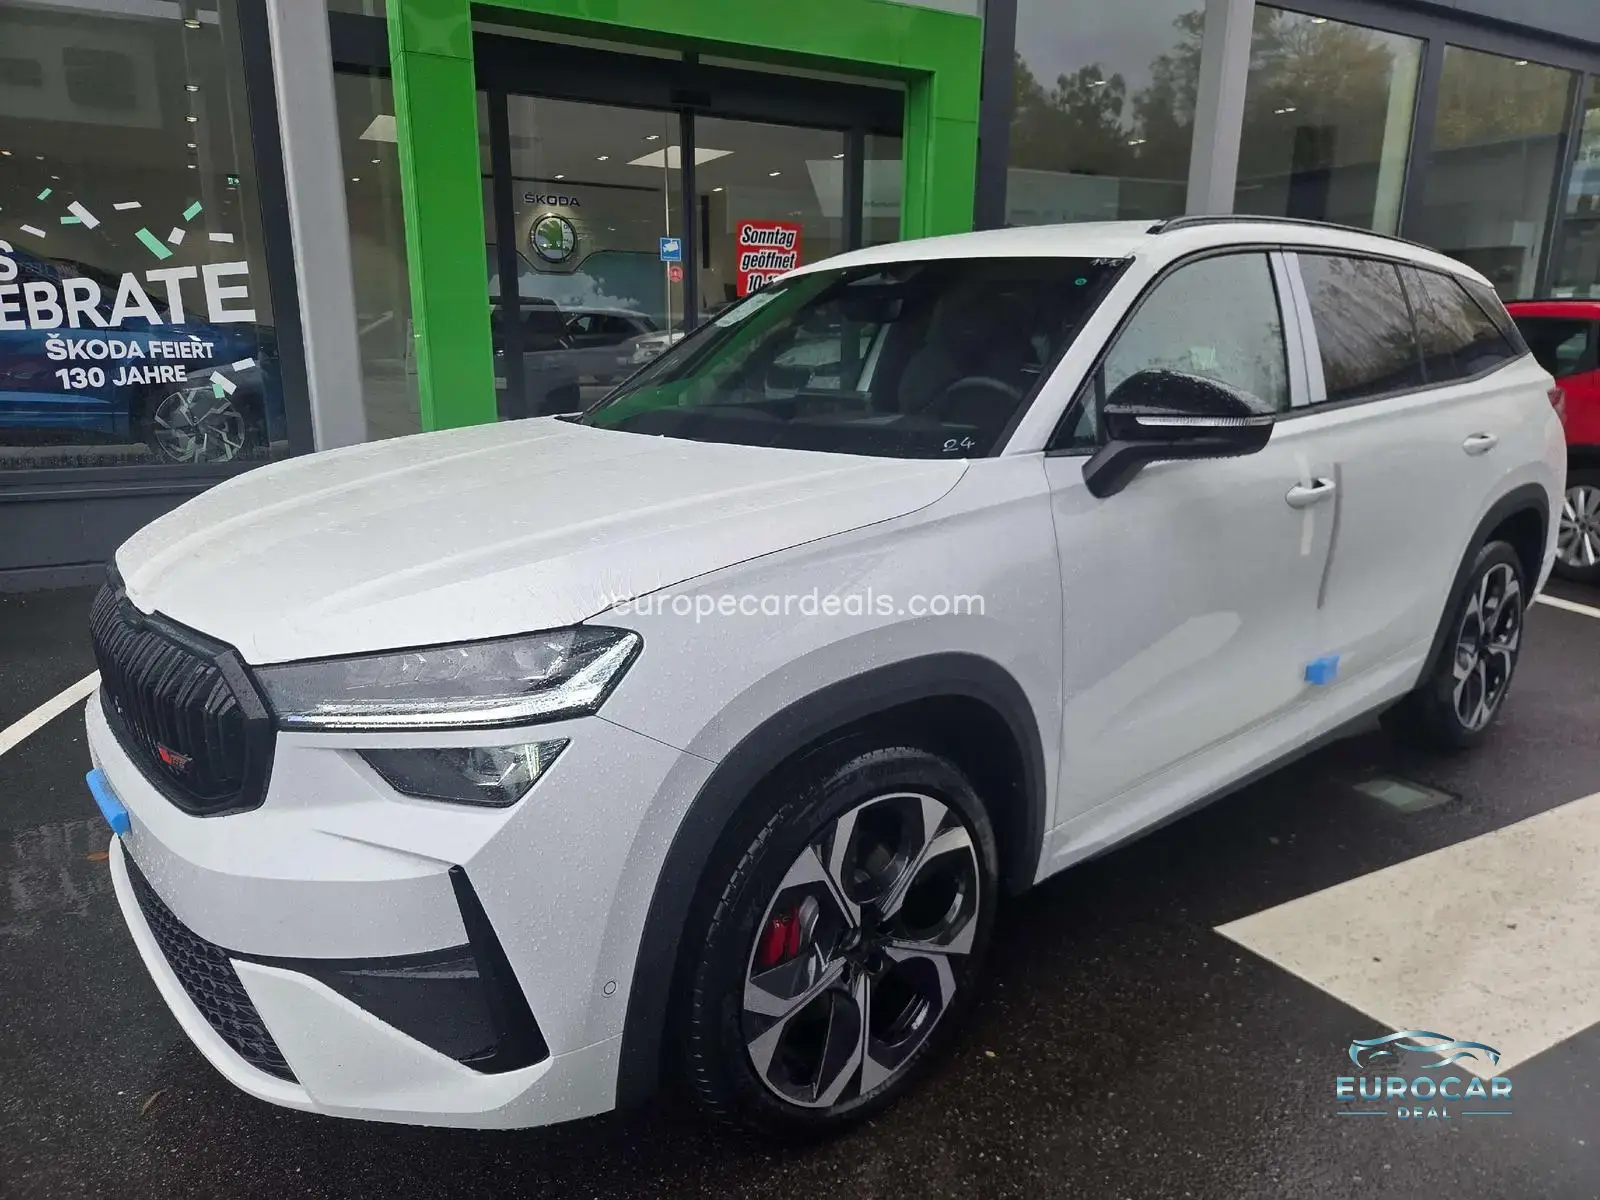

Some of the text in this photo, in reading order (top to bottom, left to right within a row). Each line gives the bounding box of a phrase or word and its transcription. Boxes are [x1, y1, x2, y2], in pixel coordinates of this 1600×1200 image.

[741, 225, 796, 249] Sonntag
[741, 251, 797, 272] geöffnet
[45, 333, 214, 360] ŠKODA FEIERT
[55, 365, 188, 390] 130 JAHRE
